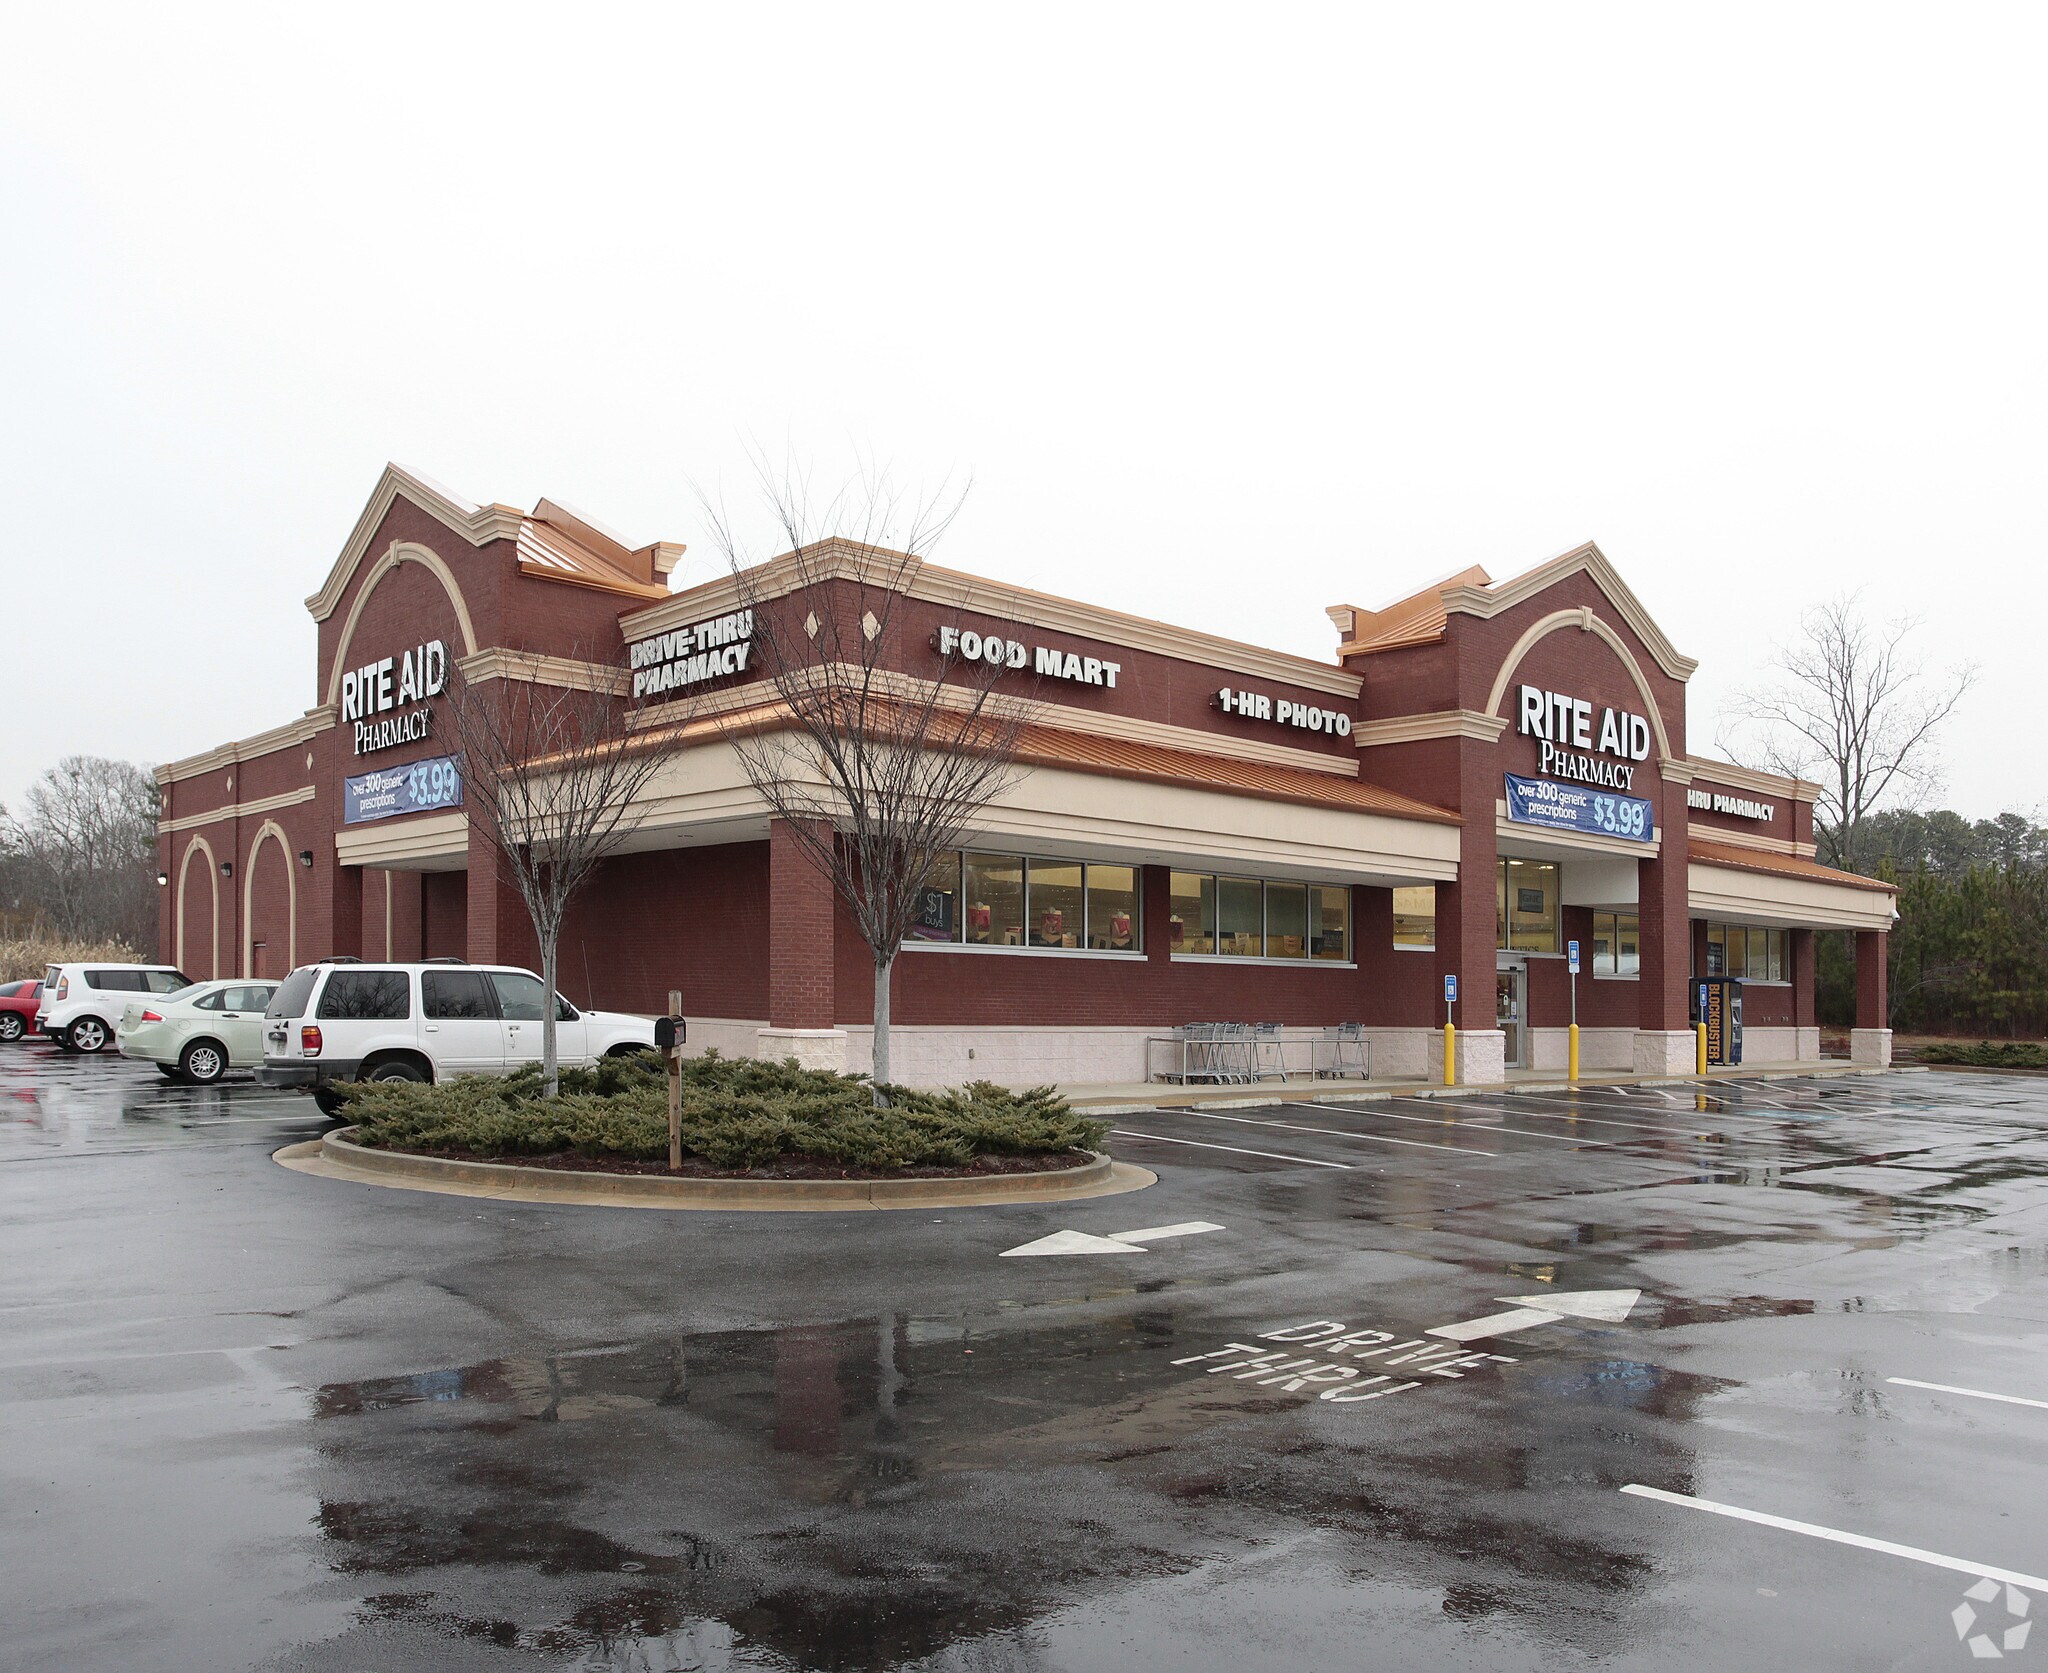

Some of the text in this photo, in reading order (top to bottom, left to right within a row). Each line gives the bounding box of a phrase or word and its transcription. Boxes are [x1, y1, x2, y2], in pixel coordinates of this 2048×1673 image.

[630, 610, 753, 669] DRIVE-THRU
[940, 626, 1121, 688] FOOD MART
[342, 640, 446, 723] RITE AID
[632, 642, 750, 698] PHARMACY
[354, 708, 432, 756] PHARMACY
[1218, 688, 1351, 737] 1-HR PHOTO
[1520, 684, 1650, 761] RITE AID
[352, 773, 404, 796] over 300 generic
[1540, 740, 1634, 790] PHARMACY
[360, 793, 395, 812] prescriptions
[1517, 781, 1587, 808] over 300 generic
[1528, 801, 1577, 820] prescriptions
[1714, 794, 1774, 821] PHARMACY
[925, 914, 943, 928] buys
[926, 891, 943, 919] $1
[1708, 983, 1720, 1060] BLOCKBUSTER
[1170, 1343, 1422, 1403] THRU
